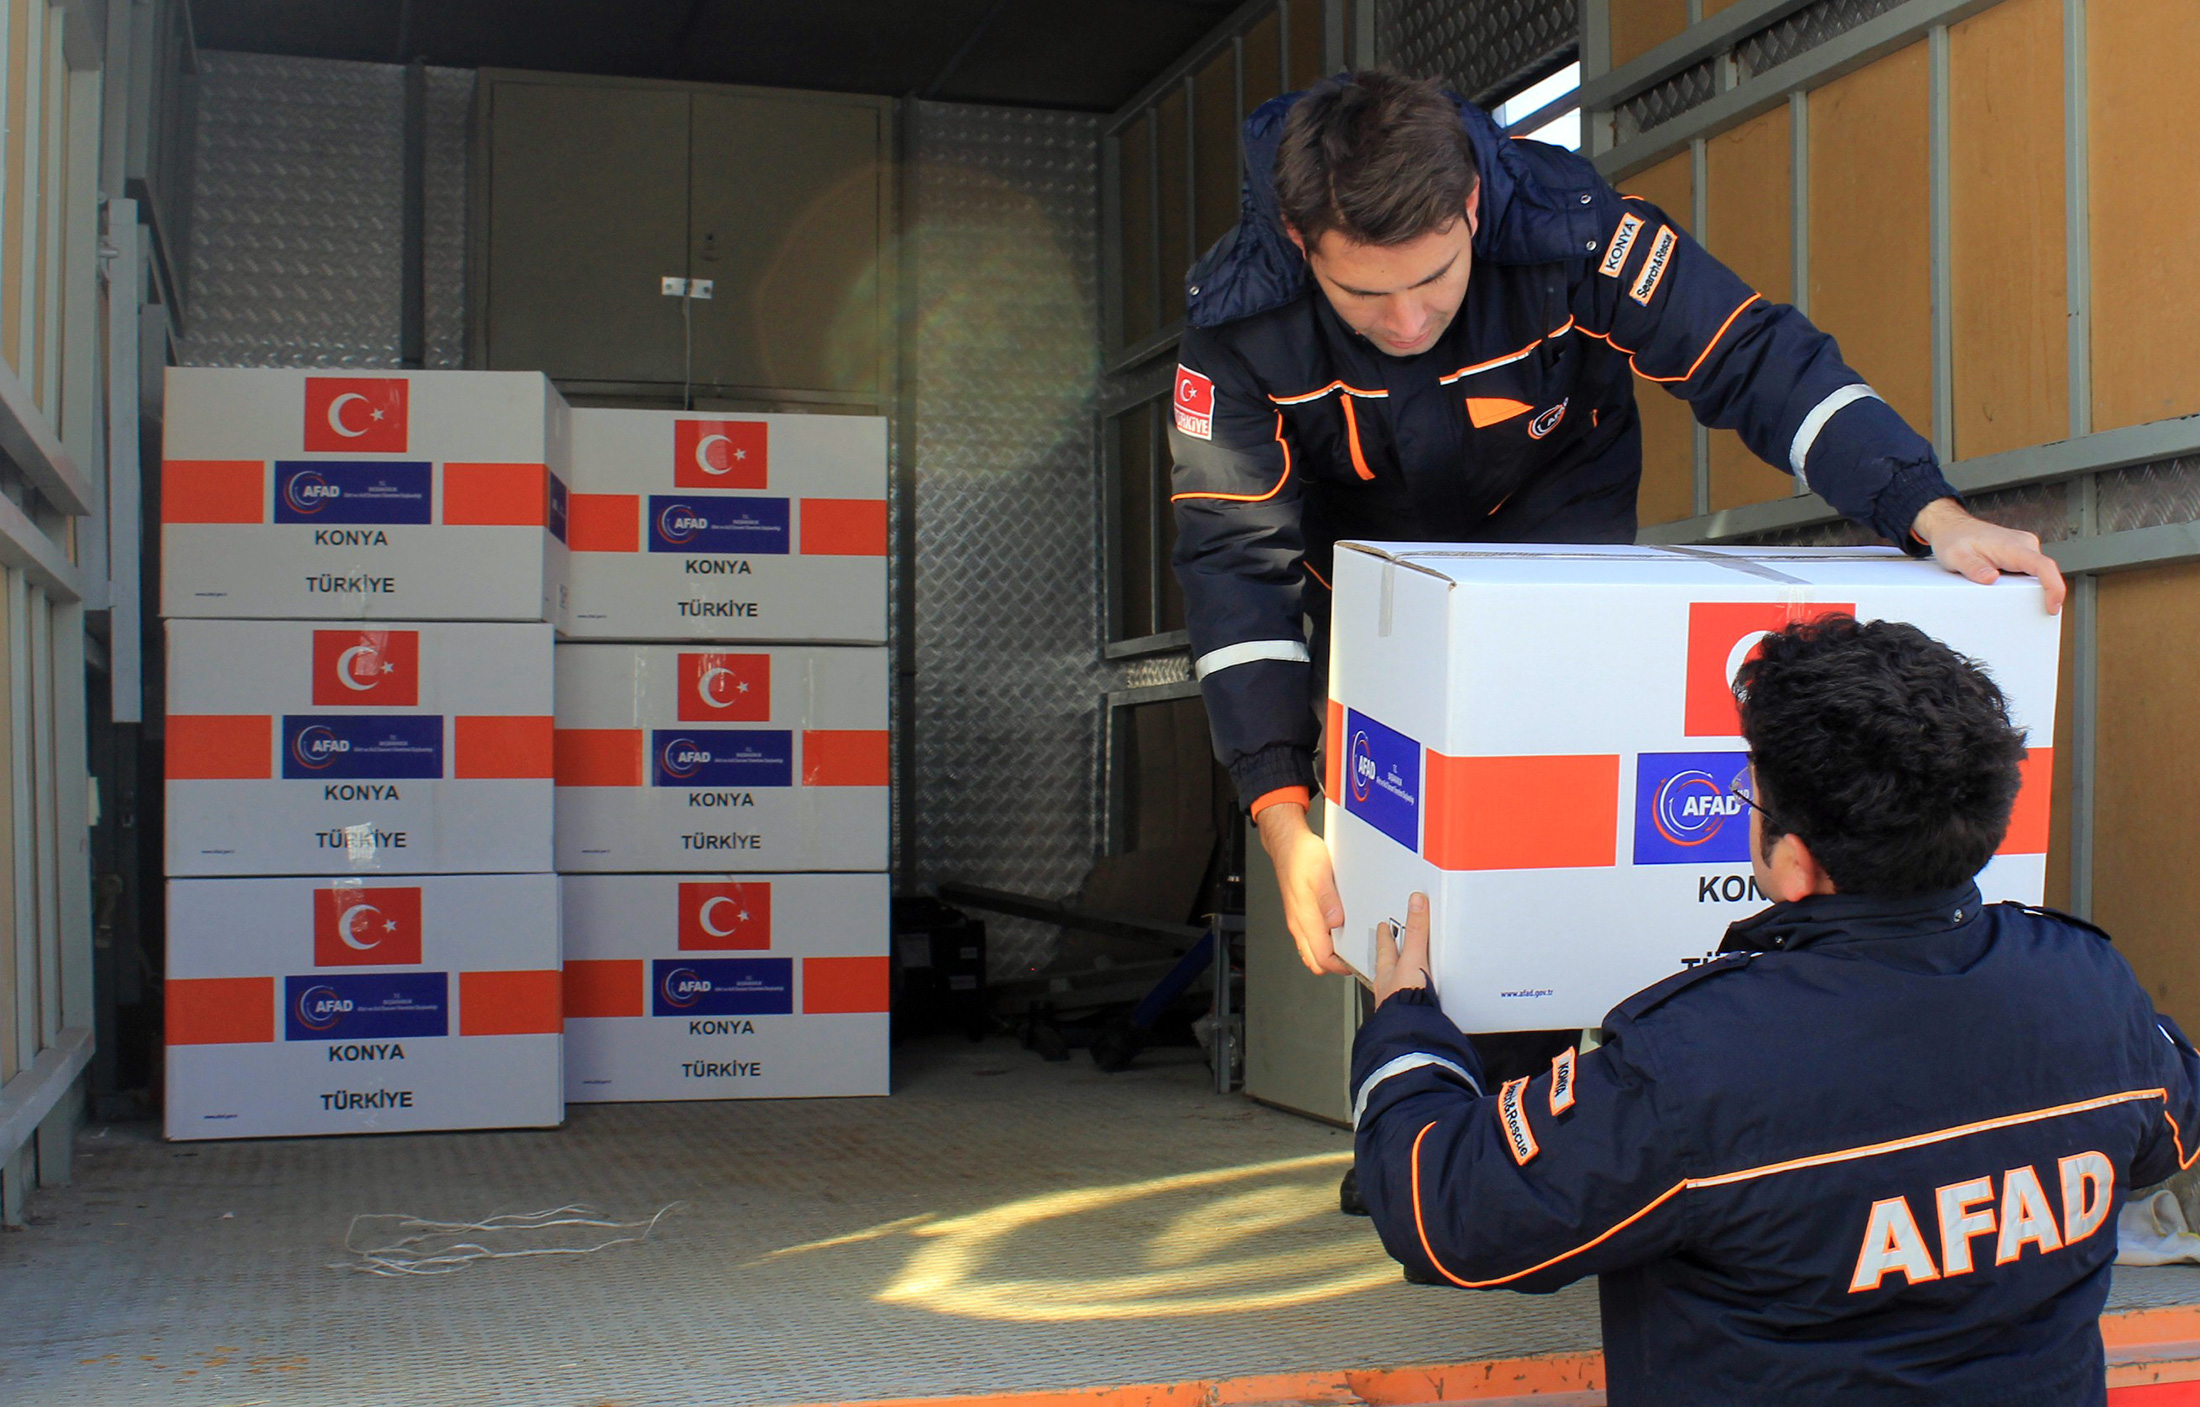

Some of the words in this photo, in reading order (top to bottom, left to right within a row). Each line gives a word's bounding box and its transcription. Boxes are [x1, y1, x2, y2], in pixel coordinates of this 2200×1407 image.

[1606, 222, 1635, 270] KONYA
[303, 485, 340, 498] AFAD
[675, 518, 708, 529] AFAD
[315, 530, 388, 546] KONYA
[686, 560, 751, 574] KONYA
[306, 574, 395, 593] TÜRKİYE
[678, 599, 758, 617] TÜRKİYE
[312, 740, 350, 752] AFAD
[678, 752, 711, 763] AFAD
[1358, 755, 1376, 780] AFAD
[325, 785, 399, 801] KONYA
[689, 793, 754, 807] KONYA
[1682, 796, 1742, 817] AFAD
[681, 832, 761, 849] TÜRKİYE
[1698, 875, 1767, 902] KON
[679, 981, 712, 992] AFAD
[315, 1000, 353, 1013] AFAD
[689, 1021, 754, 1035] KONYA
[329, 1044, 405, 1062] KONYA
[682, 1060, 761, 1077] TÜRKİYE
[320, 1089, 413, 1110] TÜRKİYE
[1848, 1150, 2115, 1293] AFAD
